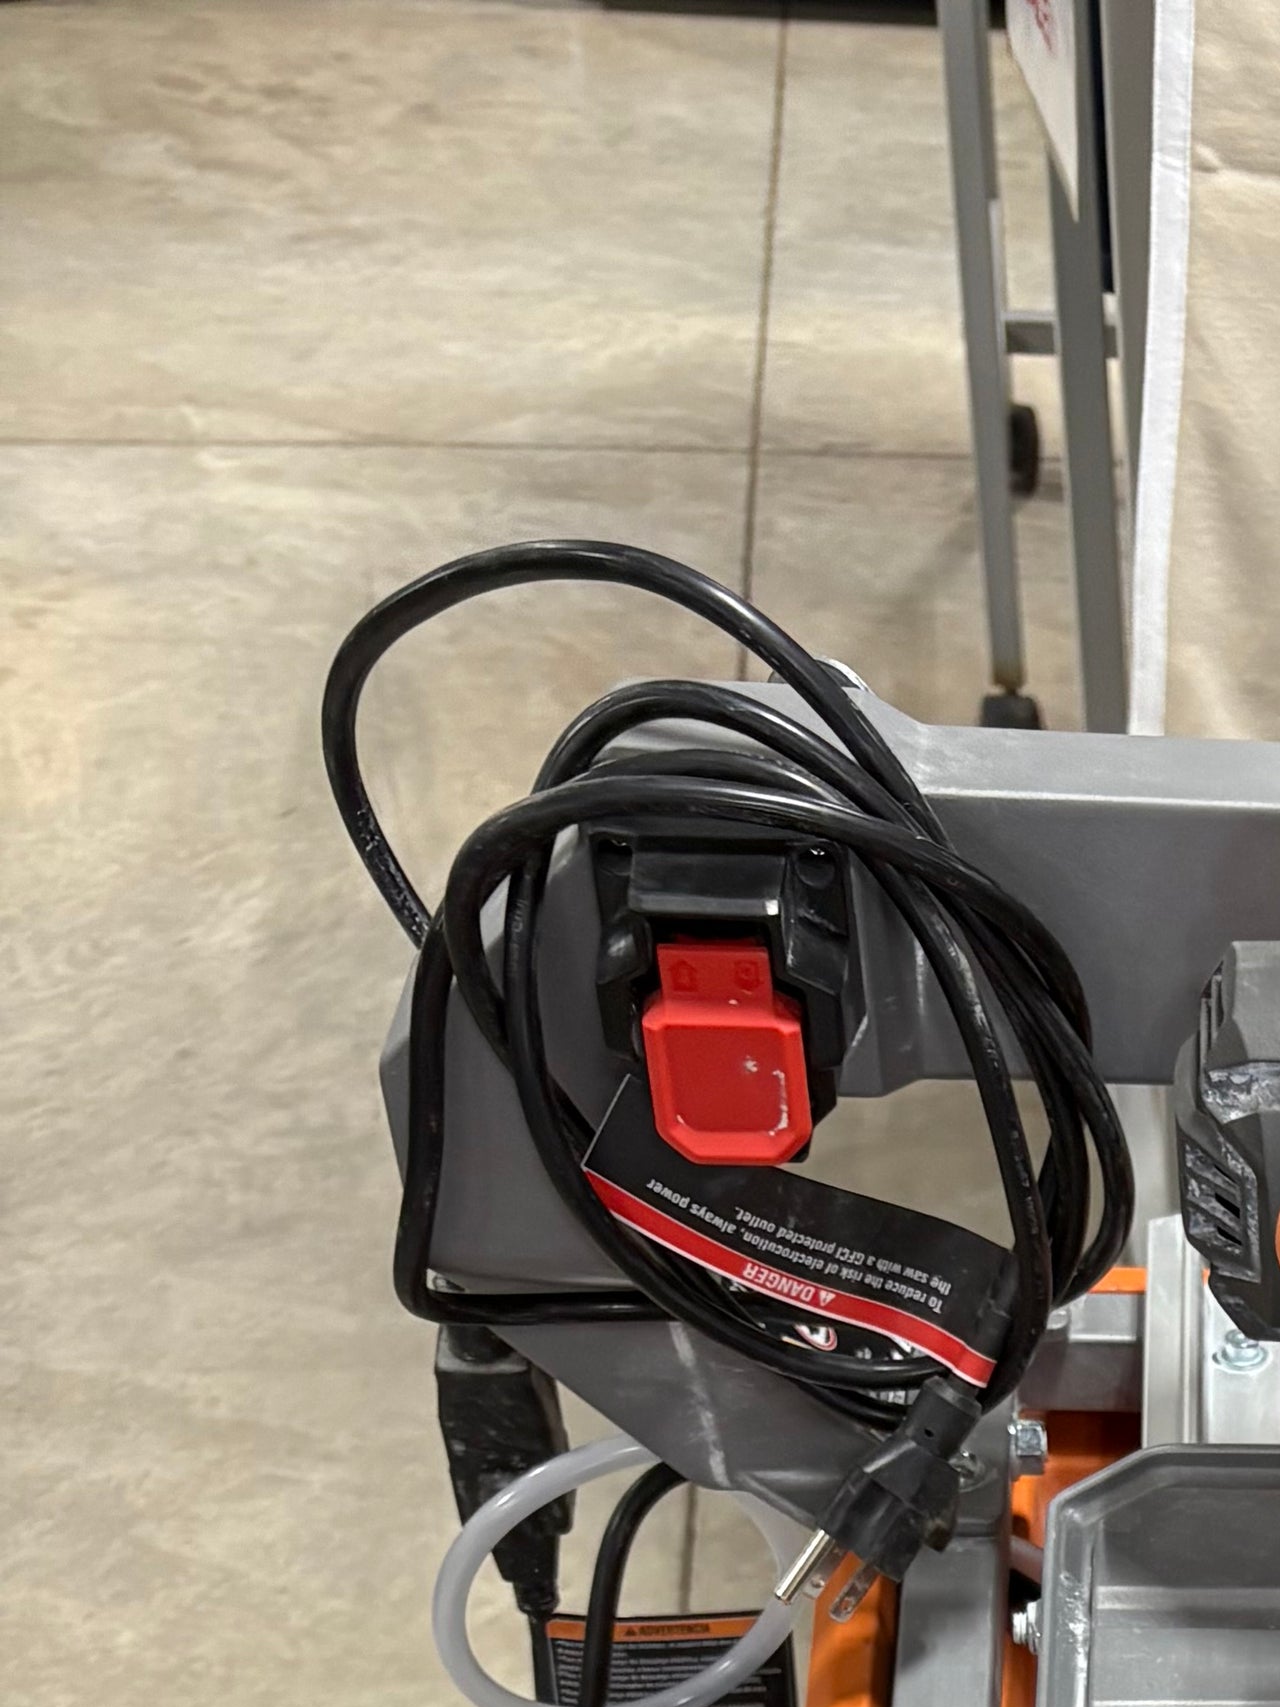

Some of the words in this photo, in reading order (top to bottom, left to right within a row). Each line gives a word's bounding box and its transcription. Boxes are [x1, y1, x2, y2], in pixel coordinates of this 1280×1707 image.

[645, 1174, 691, 1210] power
[686, 1198, 738, 1238] always
[730, 1205, 777, 1234] outlet.
[735, 1226, 826, 1272] electrocution,
[776, 1222, 836, 1256] protected
[834, 1243, 865, 1267] GFCI
[865, 1254, 876, 1266] a
[822, 1259, 839, 1277] of
[837, 1264, 864, 1286] risk
[874, 1257, 902, 1278] with
[901, 1265, 929, 1285] saw
[740, 1260, 815, 1304] DANGER
[861, 1271, 884, 1291] the
[882, 1278, 927, 1307] reduce
[927, 1275, 952, 1297] the
[925, 1294, 945, 1314] To
